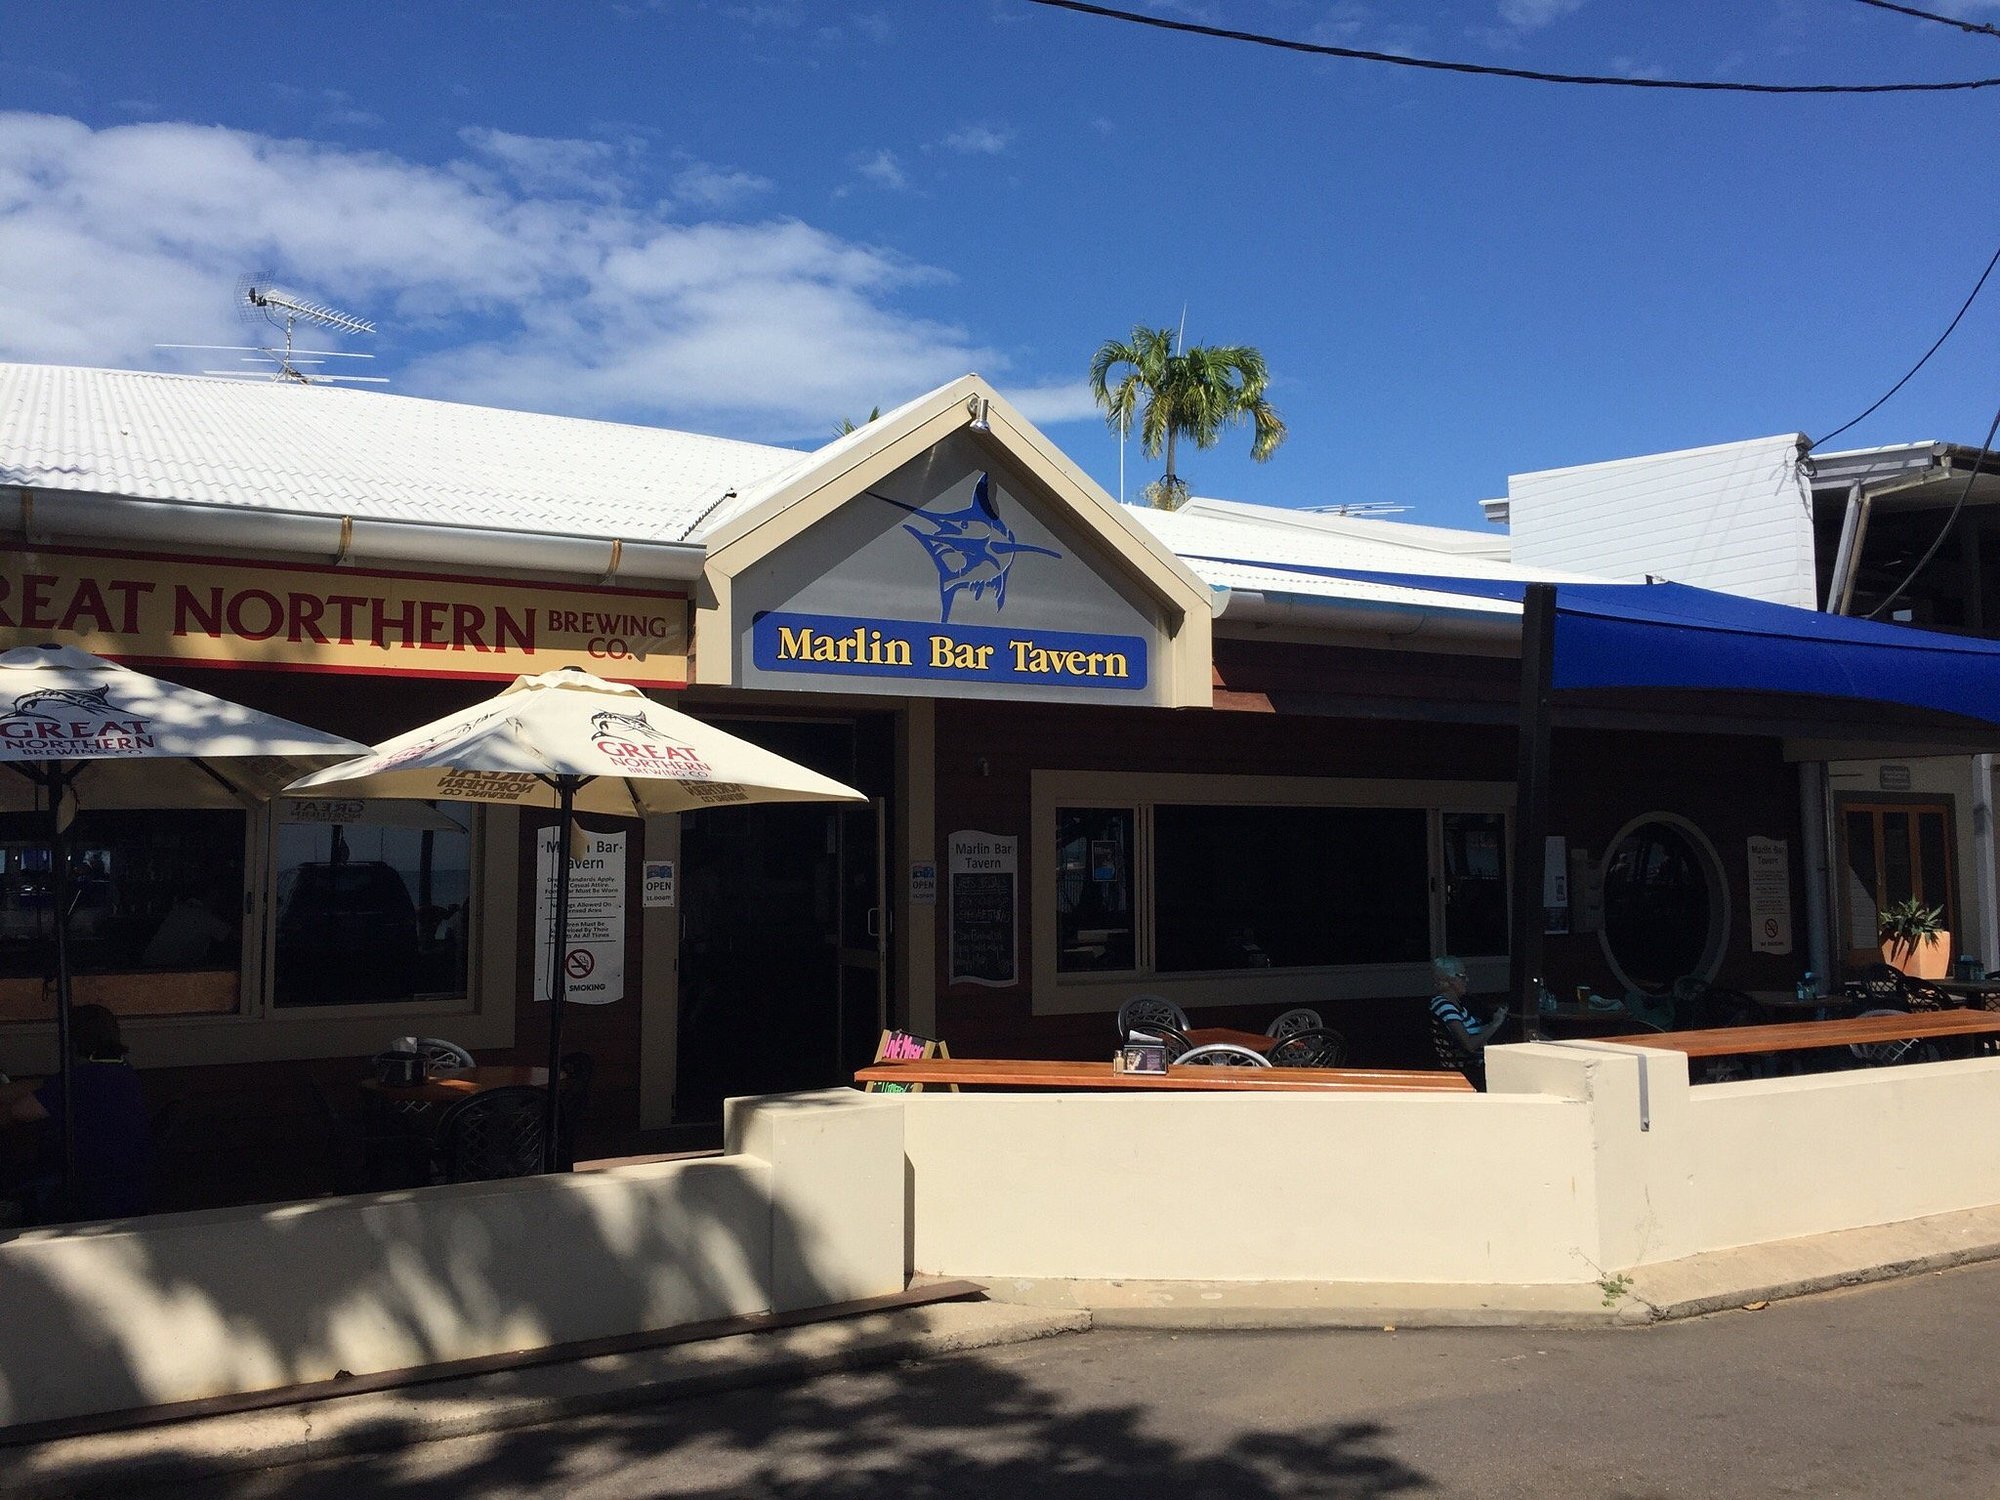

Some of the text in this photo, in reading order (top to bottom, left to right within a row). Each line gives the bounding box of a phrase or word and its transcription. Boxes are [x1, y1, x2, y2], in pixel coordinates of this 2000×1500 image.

[172, 584, 537, 655] NORTHERN
[548, 610, 666, 638] BREWING
[587, 637, 633, 660] CO.
[777, 627, 1129, 678] Marlin Bar Tavern
[0, 720, 150, 739] GREAT
[5, 735, 155, 750] NORTHERN
[597, 741, 699, 761] GREAT
[610, 757, 711, 771] NORTHERN
[597, 841, 618, 853] Bar
[955, 843, 1012, 854] Marlin Bar
[569, 859, 604, 869] avern
[965, 857, 1001, 868] Tavern
[646, 881, 671, 891] OPEN
[912, 880, 934, 889] OPEN
[569, 983, 606, 992] SMOKING
